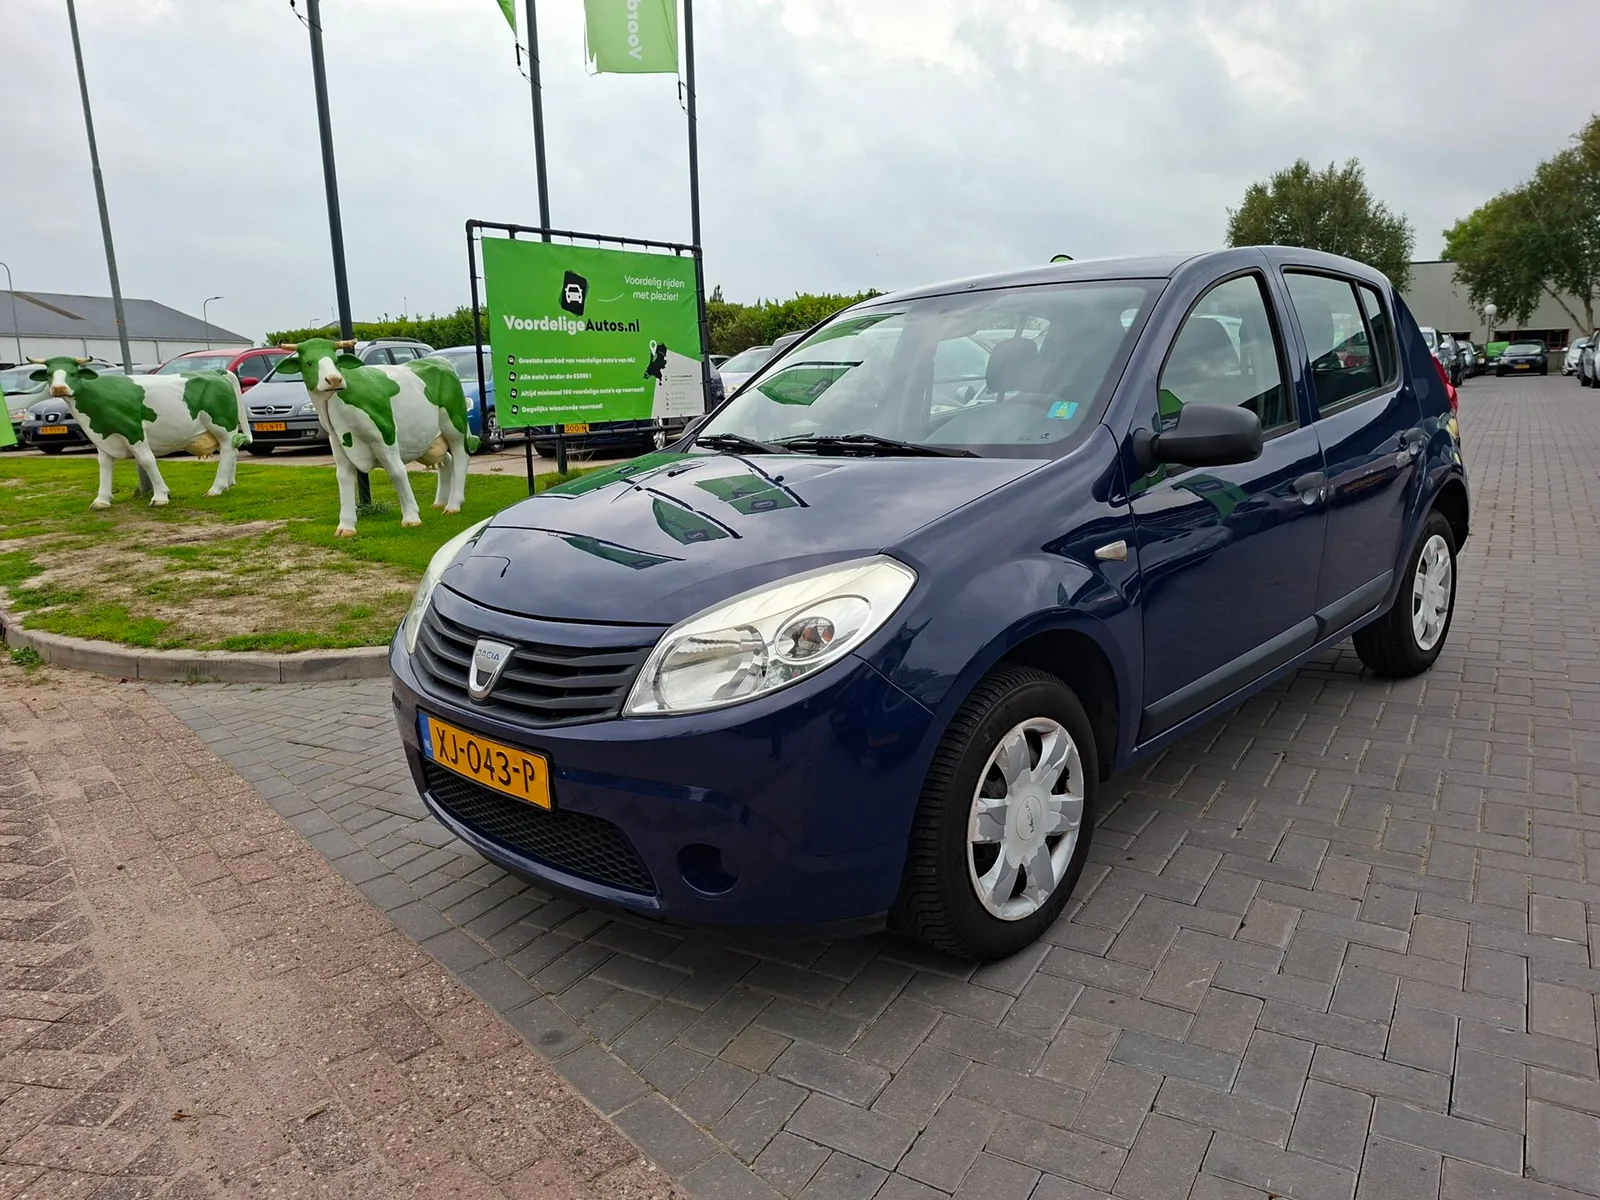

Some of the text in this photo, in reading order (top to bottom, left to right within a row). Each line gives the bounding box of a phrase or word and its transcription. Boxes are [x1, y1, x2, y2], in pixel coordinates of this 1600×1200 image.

[624, 275, 685, 290] Voordelig rijden
[633, 290, 679, 302] met plezier!
[503, 315, 640, 335] VoordeligeAutos.nl
[522, 405, 548, 413] Dagelijks
[476, 648, 500, 660] DACIA
[435, 726, 535, 793] XJ-043-P
